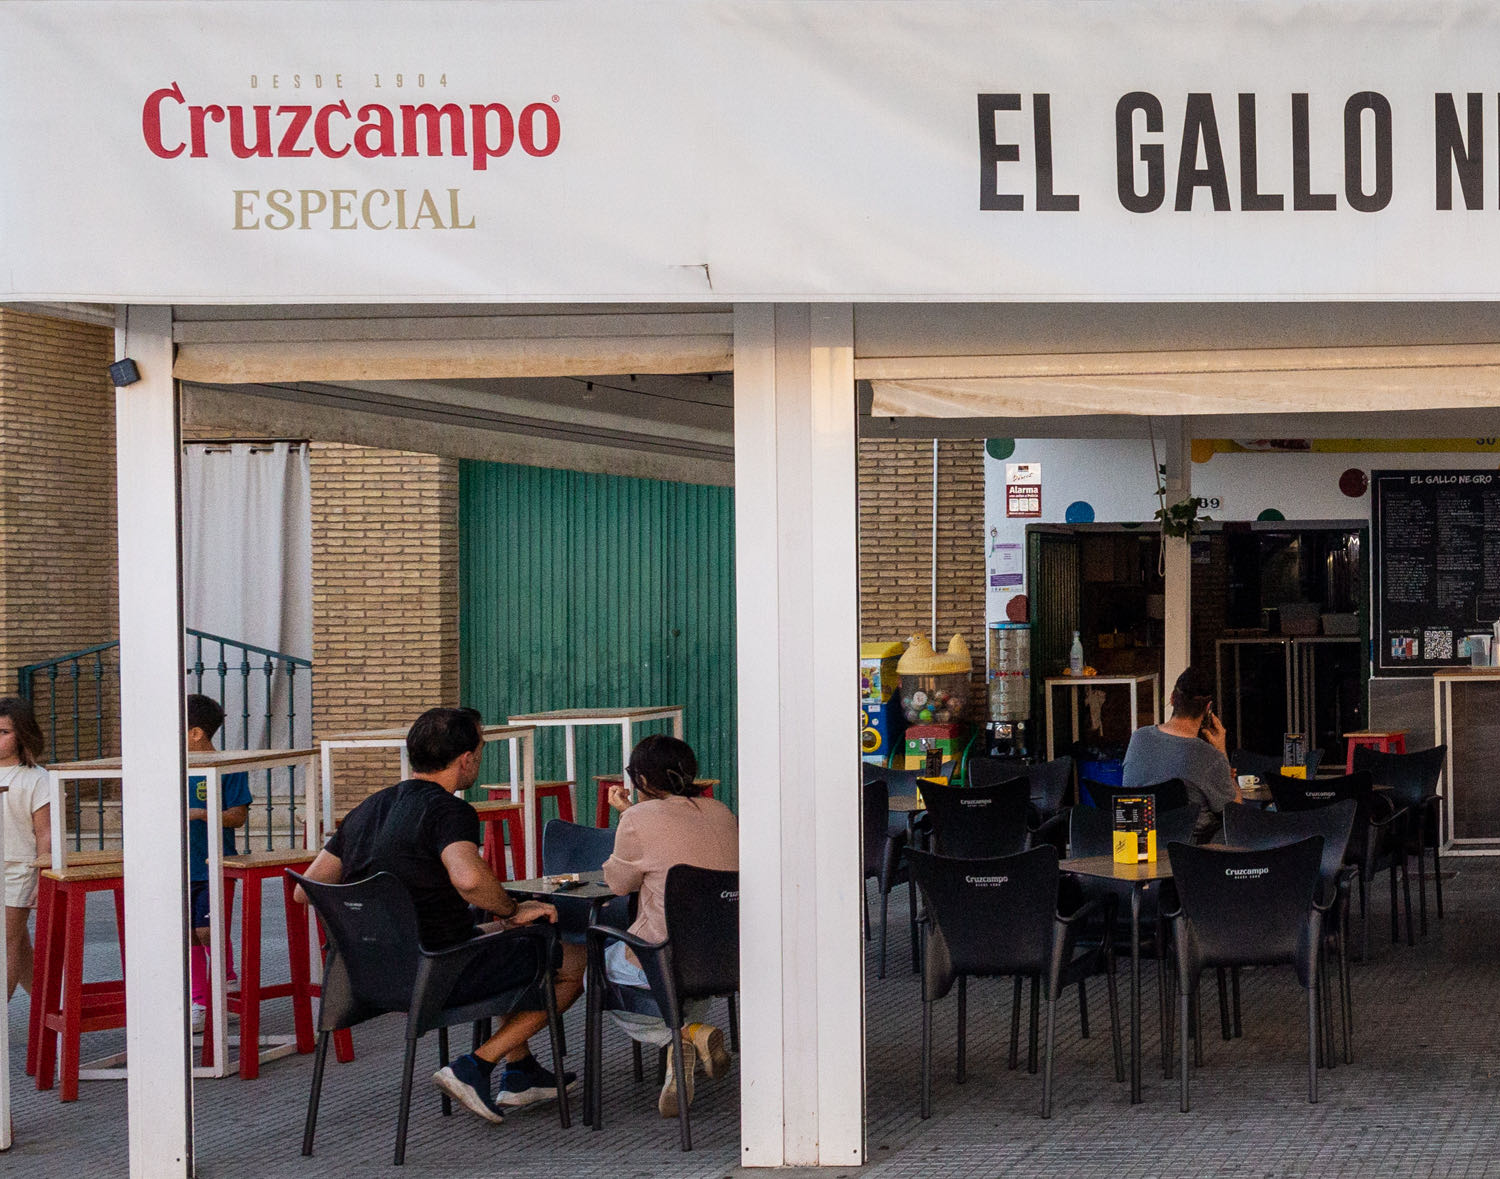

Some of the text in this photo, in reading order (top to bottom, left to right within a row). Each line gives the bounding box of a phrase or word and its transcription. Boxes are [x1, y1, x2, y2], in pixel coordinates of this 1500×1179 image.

[251, 73, 448, 89] DESDE 1904
[142, 81, 561, 171] Cruzcampo
[977, 92, 1080, 212] EL
[1115, 91, 1393, 213] GALLO
[231, 188, 477, 231] ESPECIAL
[1410, 474, 1493, 484] EL GALLO NEGRO
[1009, 485, 1039, 494] Alarma
[1225, 867, 1269, 876] Cruzcampo
[965, 874, 1008, 884] Cruzcampo
